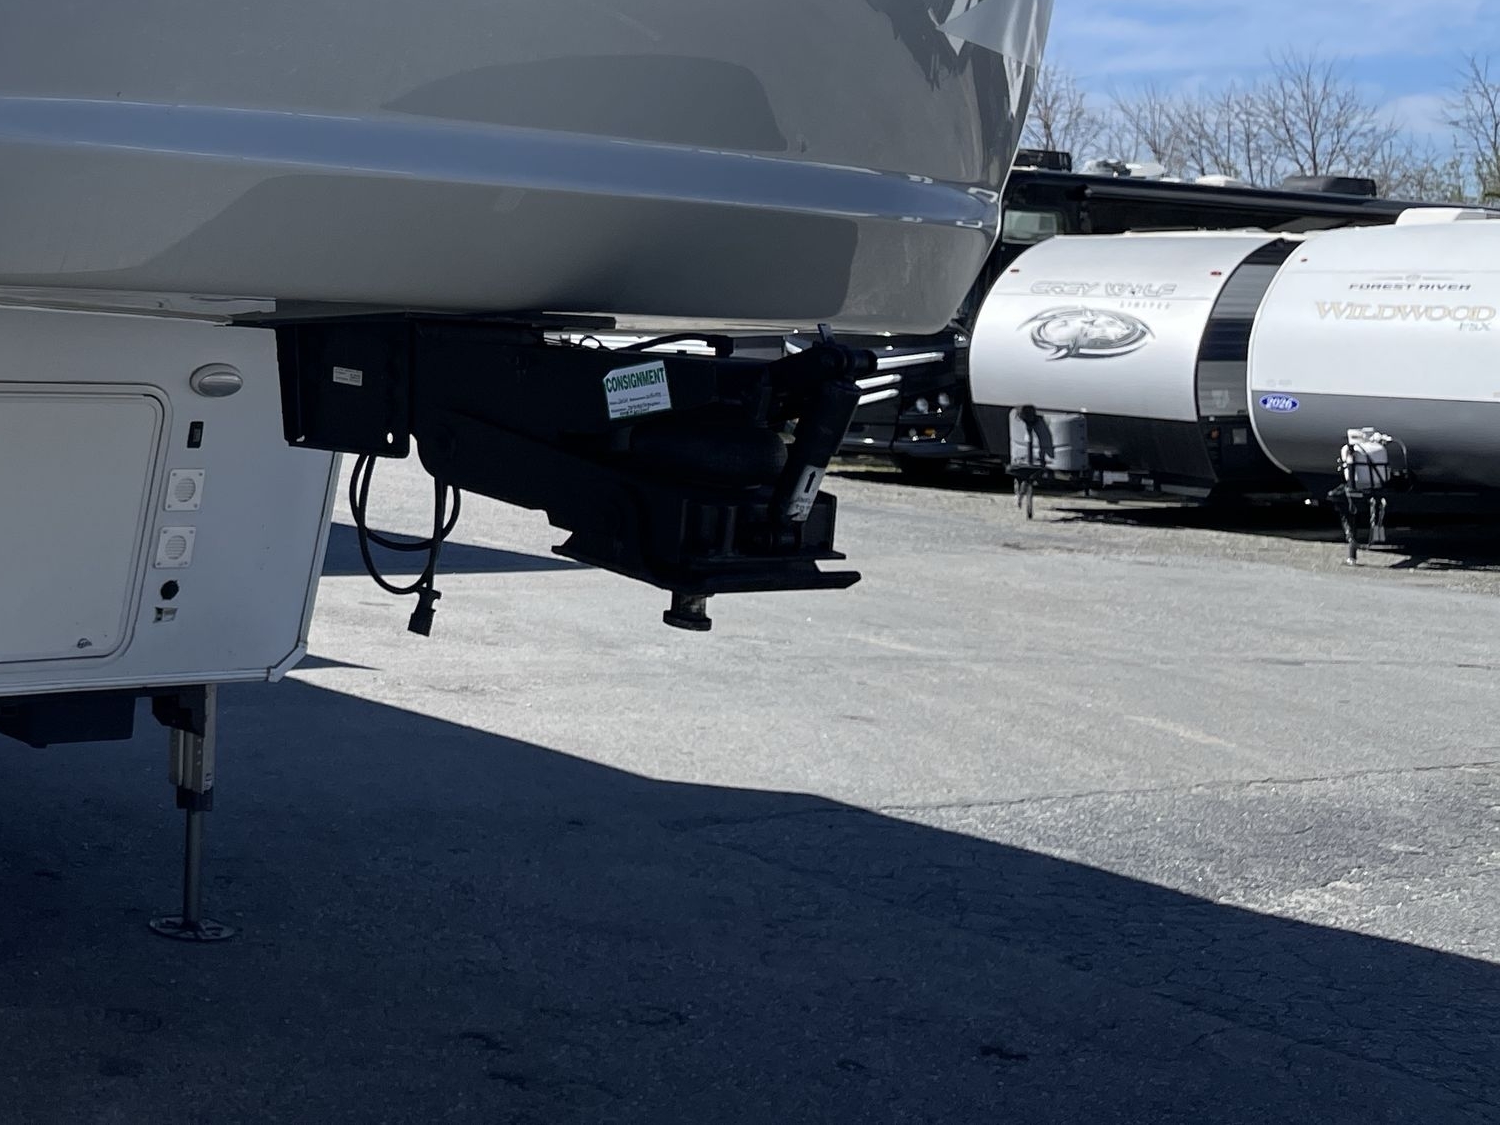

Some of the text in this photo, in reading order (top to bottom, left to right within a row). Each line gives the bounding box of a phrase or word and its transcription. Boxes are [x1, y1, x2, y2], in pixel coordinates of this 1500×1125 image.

[1030, 279, 1100, 296] GREY
[1349, 282, 1472, 291] FOREST RIVER
[1314, 300, 1497, 322] WILDWOOD
[605, 367, 665, 394] CONSIGNMENT
[1265, 396, 1293, 411] 2026
